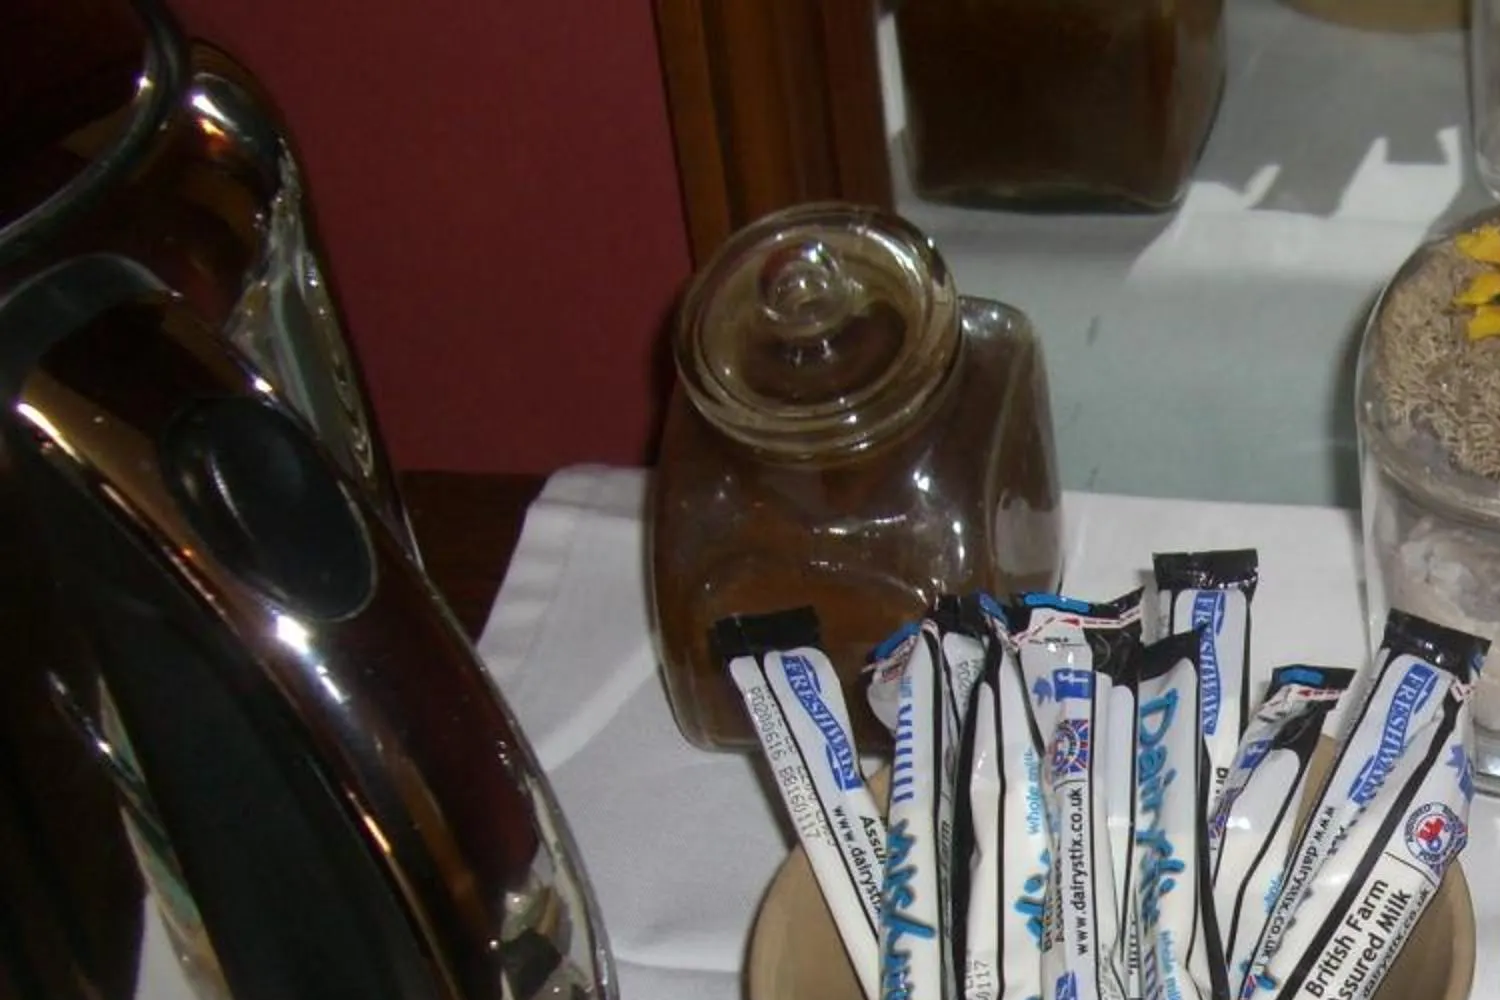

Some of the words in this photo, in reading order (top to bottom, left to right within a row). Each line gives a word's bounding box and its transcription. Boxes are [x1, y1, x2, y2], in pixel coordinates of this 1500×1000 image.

[781, 655, 863, 792] FRESHWAYS
[1194, 592, 1220, 736] FRSHWAYS
[1351, 665, 1434, 804] FRESHWAYS
[1024, 788, 1042, 836] whole
[1069, 787, 1089, 956] www.dairystix.co.uk
[1305, 935, 1355, 999] British
[1347, 878, 1390, 930] Farm
[1378, 890, 1413, 934] Milk
